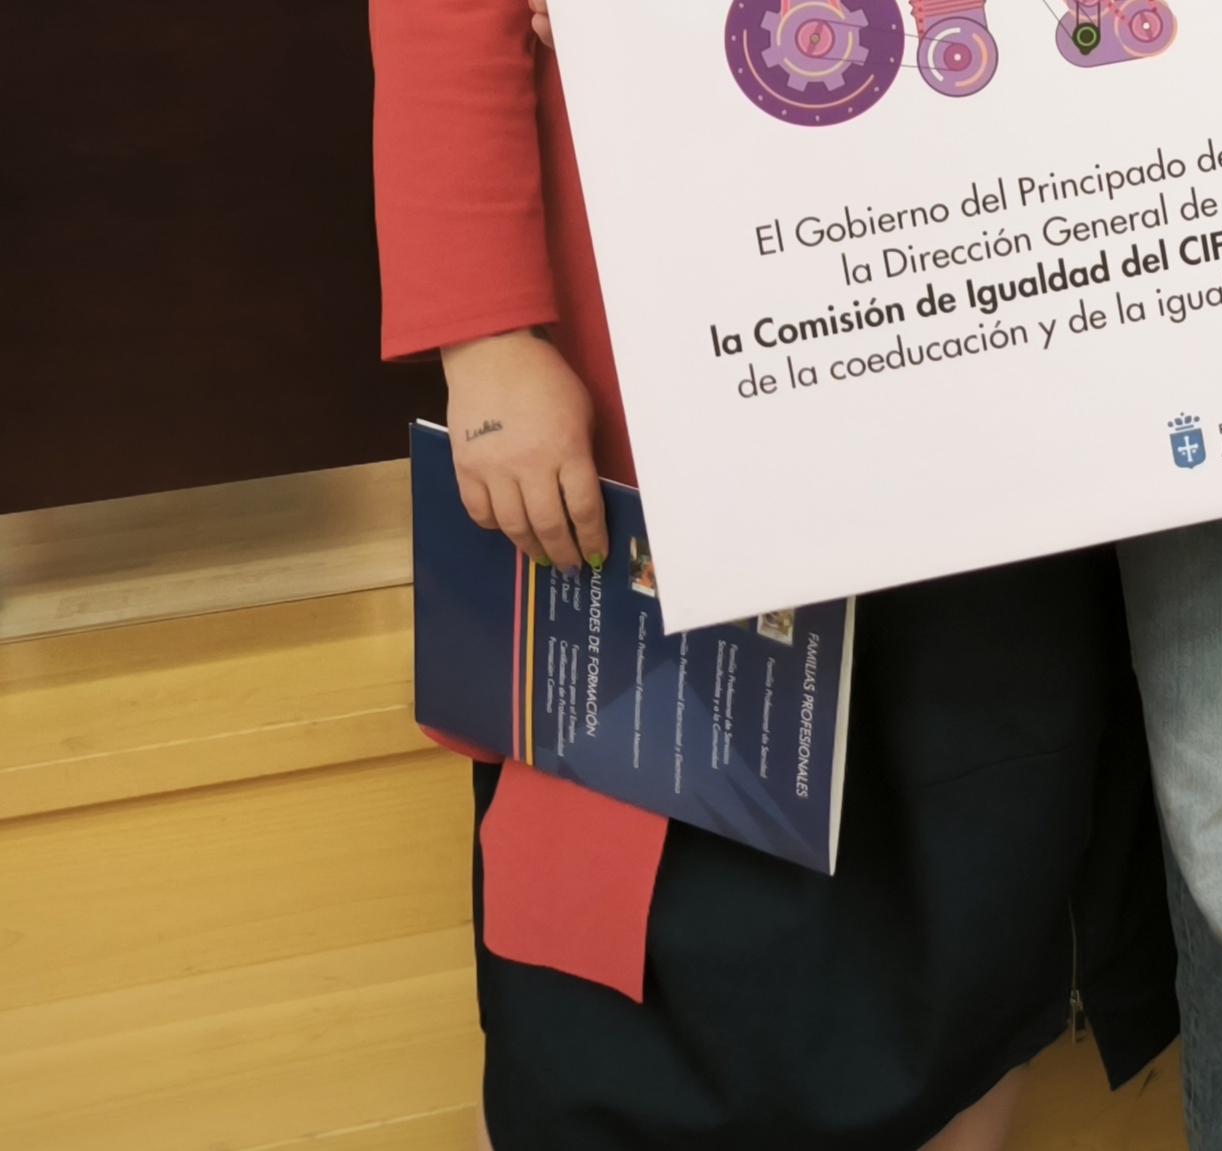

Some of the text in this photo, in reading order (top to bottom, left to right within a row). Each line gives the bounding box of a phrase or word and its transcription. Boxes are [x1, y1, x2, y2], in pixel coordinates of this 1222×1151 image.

[756, 219, 784, 255] El
[795, 205, 949, 247] Gobierno
[961, 176, 1007, 217] del
[1018, 147, 1186, 207] Principado
[842, 252, 872, 286] la
[883, 227, 1032, 278] Dirección
[1043, 192, 1168, 246] General
[1180, 186, 1218, 221] de
[710, 324, 743, 357] la
[753, 297, 905, 348] Comisión
[916, 283, 956, 318] de
[966, 249, 1111, 314] Igualdad
[1121, 238, 1169, 278] del
[738, 363, 778, 399] de
[787, 355, 818, 389] la
[829, 320, 1028, 380] coeducación
[1038, 319, 1056, 350] y
[1068, 298, 1107, 334] de
[1116, 291, 1146, 324] la
[585, 655, 600, 737] FORMACIÓN
[588, 635, 600, 654] DE
[796, 631, 819, 798] FAMILIAS PROFESIONALES
